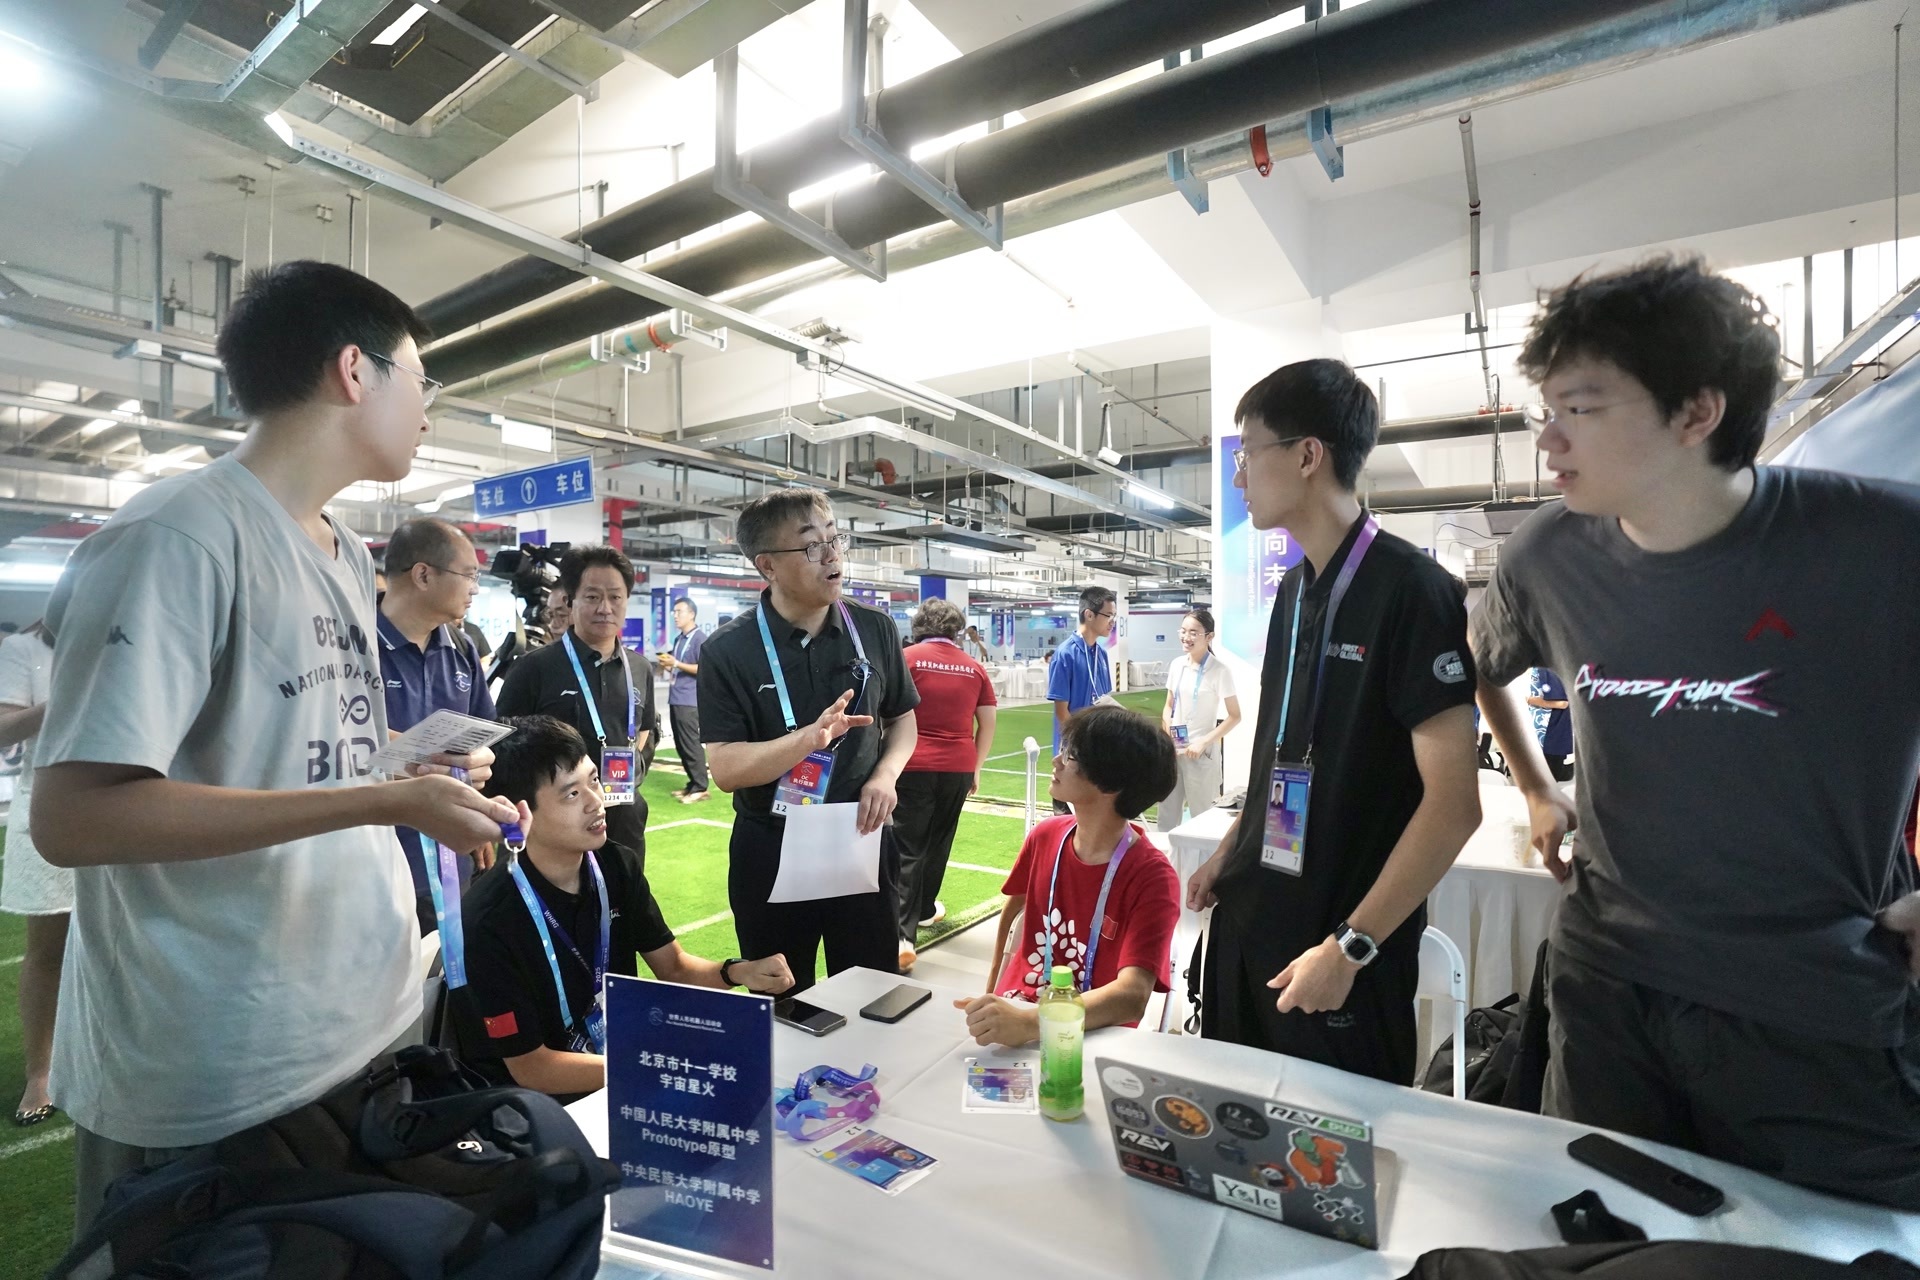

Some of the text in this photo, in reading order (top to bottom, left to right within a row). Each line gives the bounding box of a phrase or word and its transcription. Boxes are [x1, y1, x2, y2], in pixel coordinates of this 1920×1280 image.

[556, 470, 585, 495] 车位
[480, 485, 505, 509] 车位
[1340, 651, 1364, 662] GLOBAL
[1341, 643, 1359, 652] FIRST
[611, 770, 626, 779] VIP
[543, 909, 560, 930] WHRG
[639, 1051, 738, 1082] 北京市十一学校
[659, 1073, 716, 1098] 宇宙星火
[620, 1104, 760, 1146] 中国人民大学附属中学
[1269, 1105, 1320, 1126] REV
[641, 1127, 737, 1161] Prototype原型
[1120, 1128, 1171, 1152] REV
[621, 1161, 761, 1206] 中央民族大学附属中学
[664, 1190, 715, 1213] HAOYE
